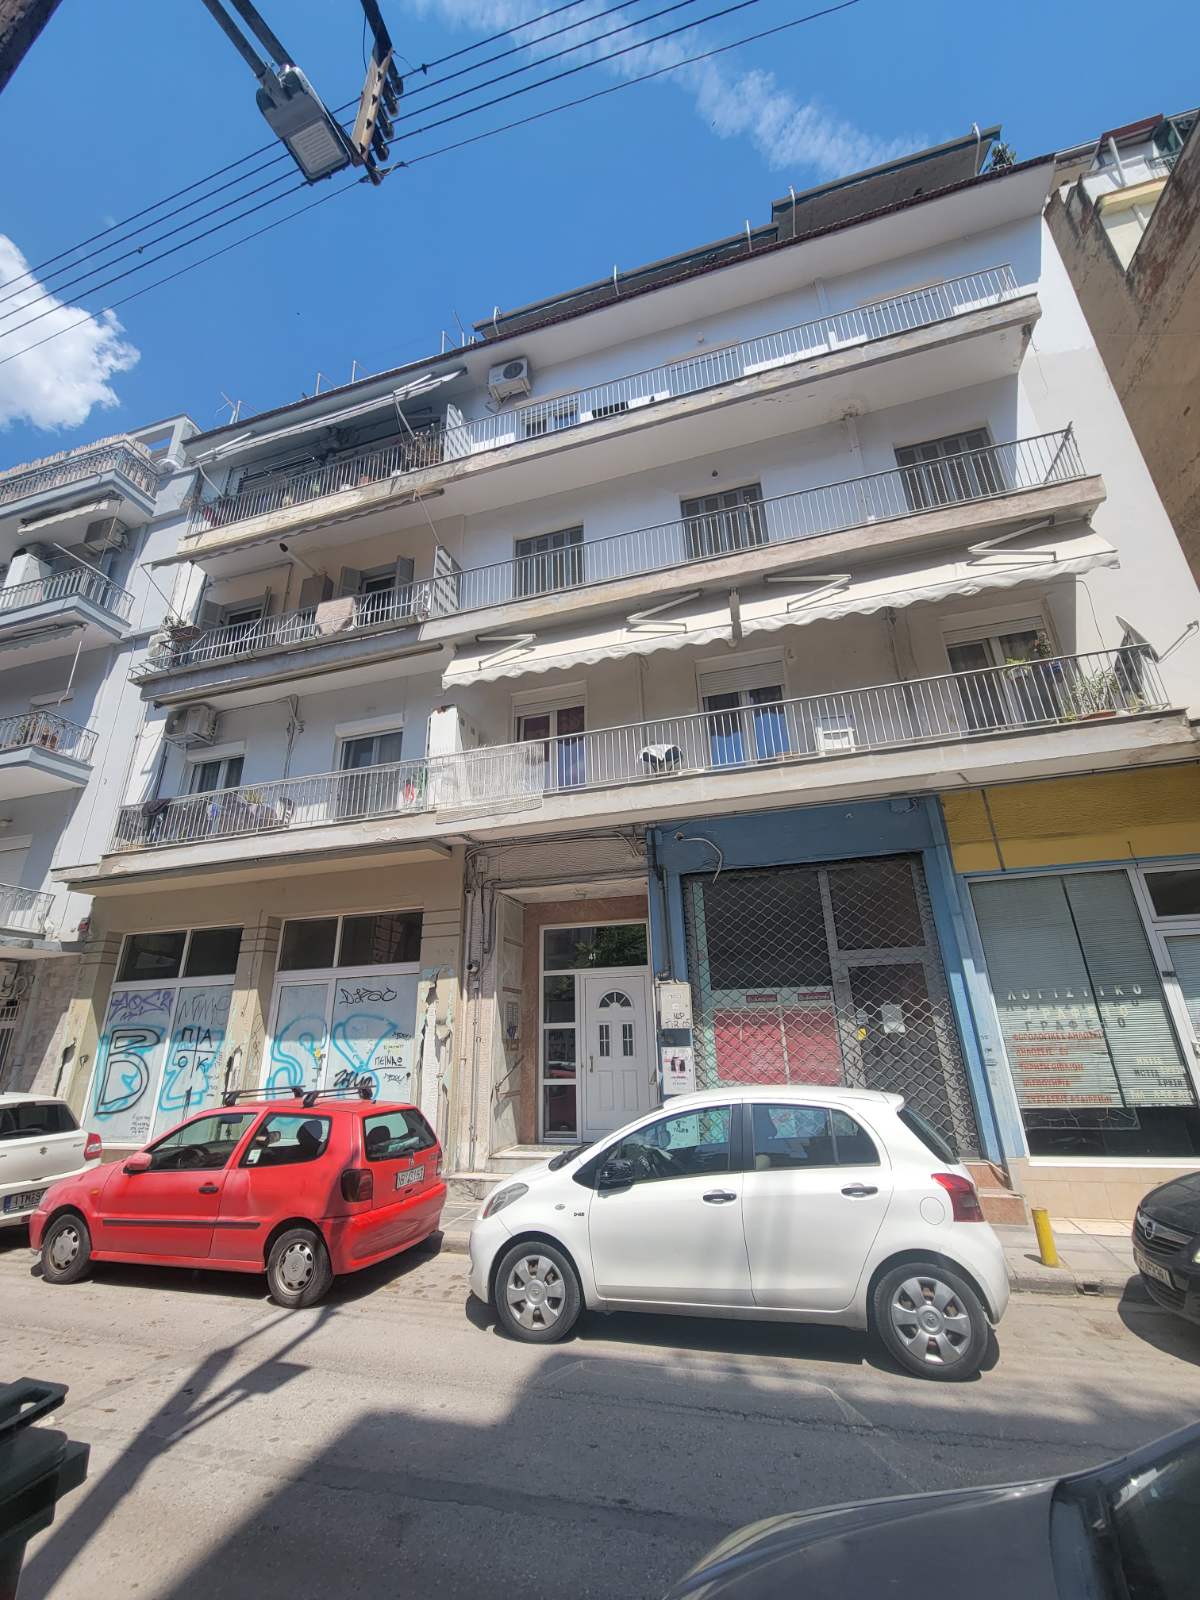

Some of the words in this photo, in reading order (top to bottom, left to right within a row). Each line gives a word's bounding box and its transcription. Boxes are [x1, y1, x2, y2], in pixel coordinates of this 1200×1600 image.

[588, 952, 597, 961] 41
[1007, 984, 1142, 1000] ΛΟΓΙΣΤΙΚΟ
[1026, 1005, 1129, 1020] ΓΡΑΦΕΙΟ
